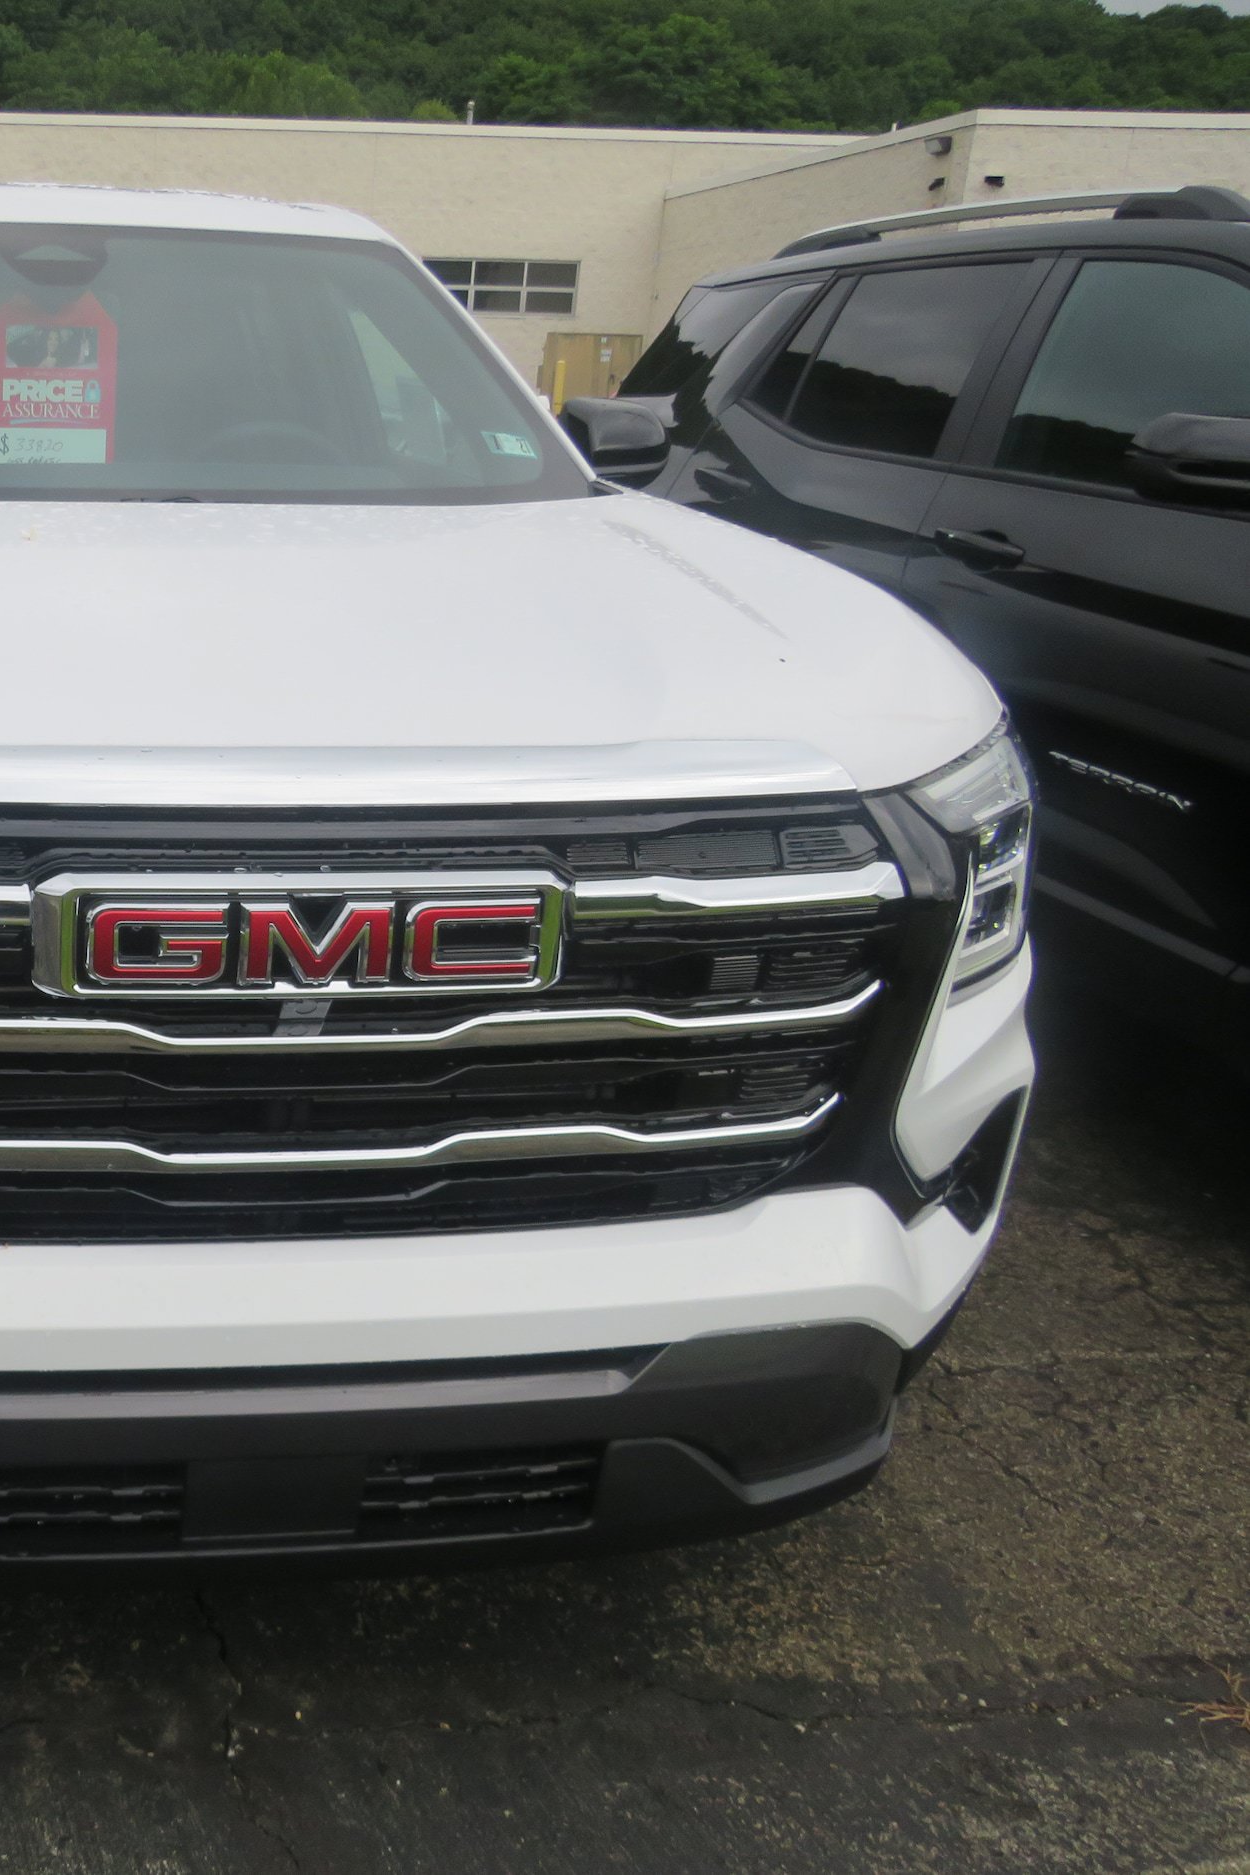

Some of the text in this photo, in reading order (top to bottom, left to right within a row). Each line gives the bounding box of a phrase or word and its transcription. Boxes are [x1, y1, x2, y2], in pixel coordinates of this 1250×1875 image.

[2, 378, 84, 402] PRICE
[2, 402, 100, 419] ASSURANCE
[86, 899, 541, 986] GMC
